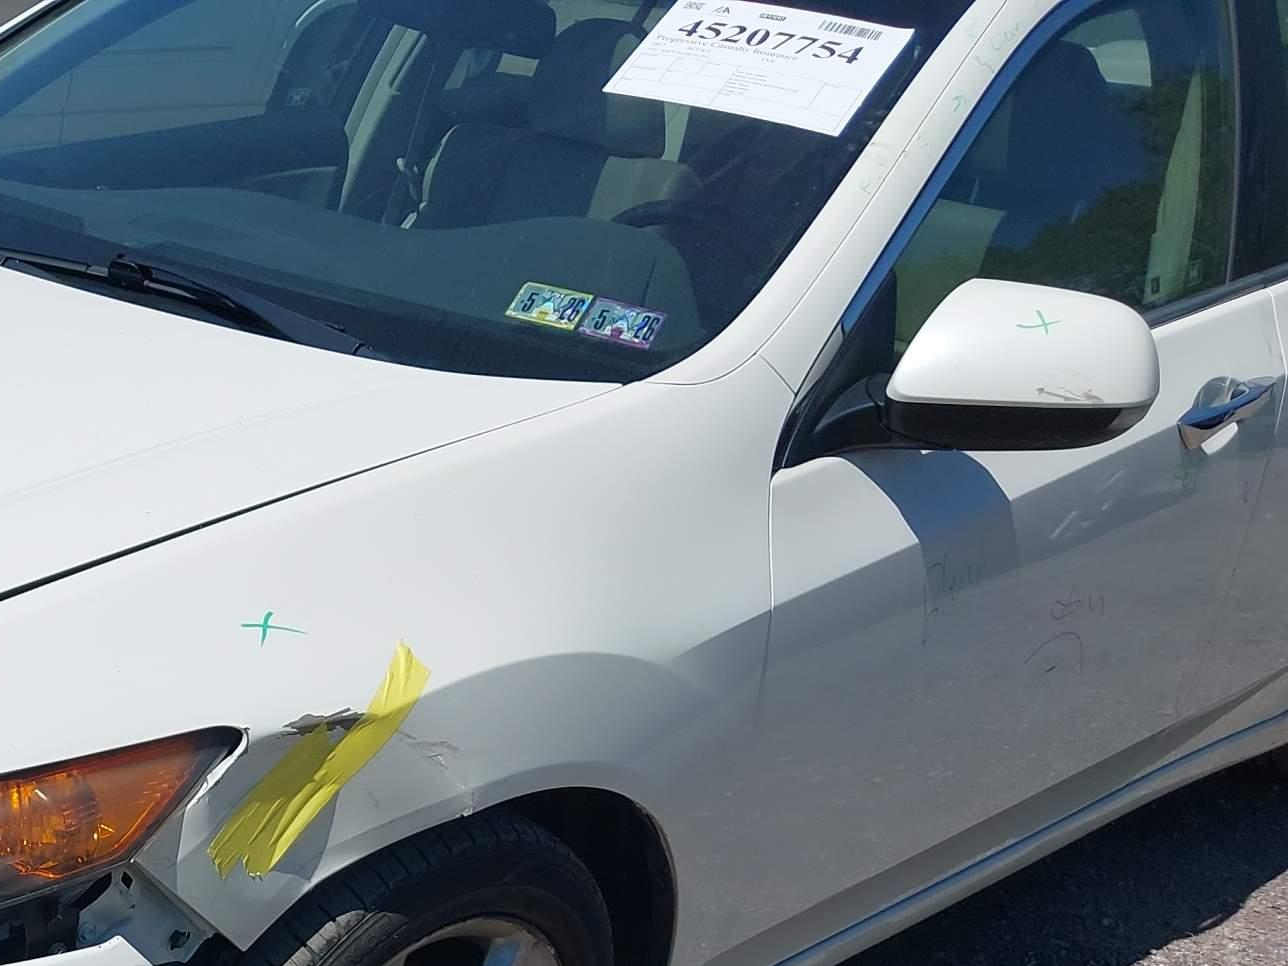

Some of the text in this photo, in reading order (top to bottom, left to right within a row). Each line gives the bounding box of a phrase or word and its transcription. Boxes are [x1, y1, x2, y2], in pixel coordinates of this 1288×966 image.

[657, 34, 708, 47] Progressive
[752, 47, 799, 62] Insurance
[677, 19, 866, 65] 45207754
[521, 292, 587, 323] 5 26
[593, 309, 661, 342] 5 26
